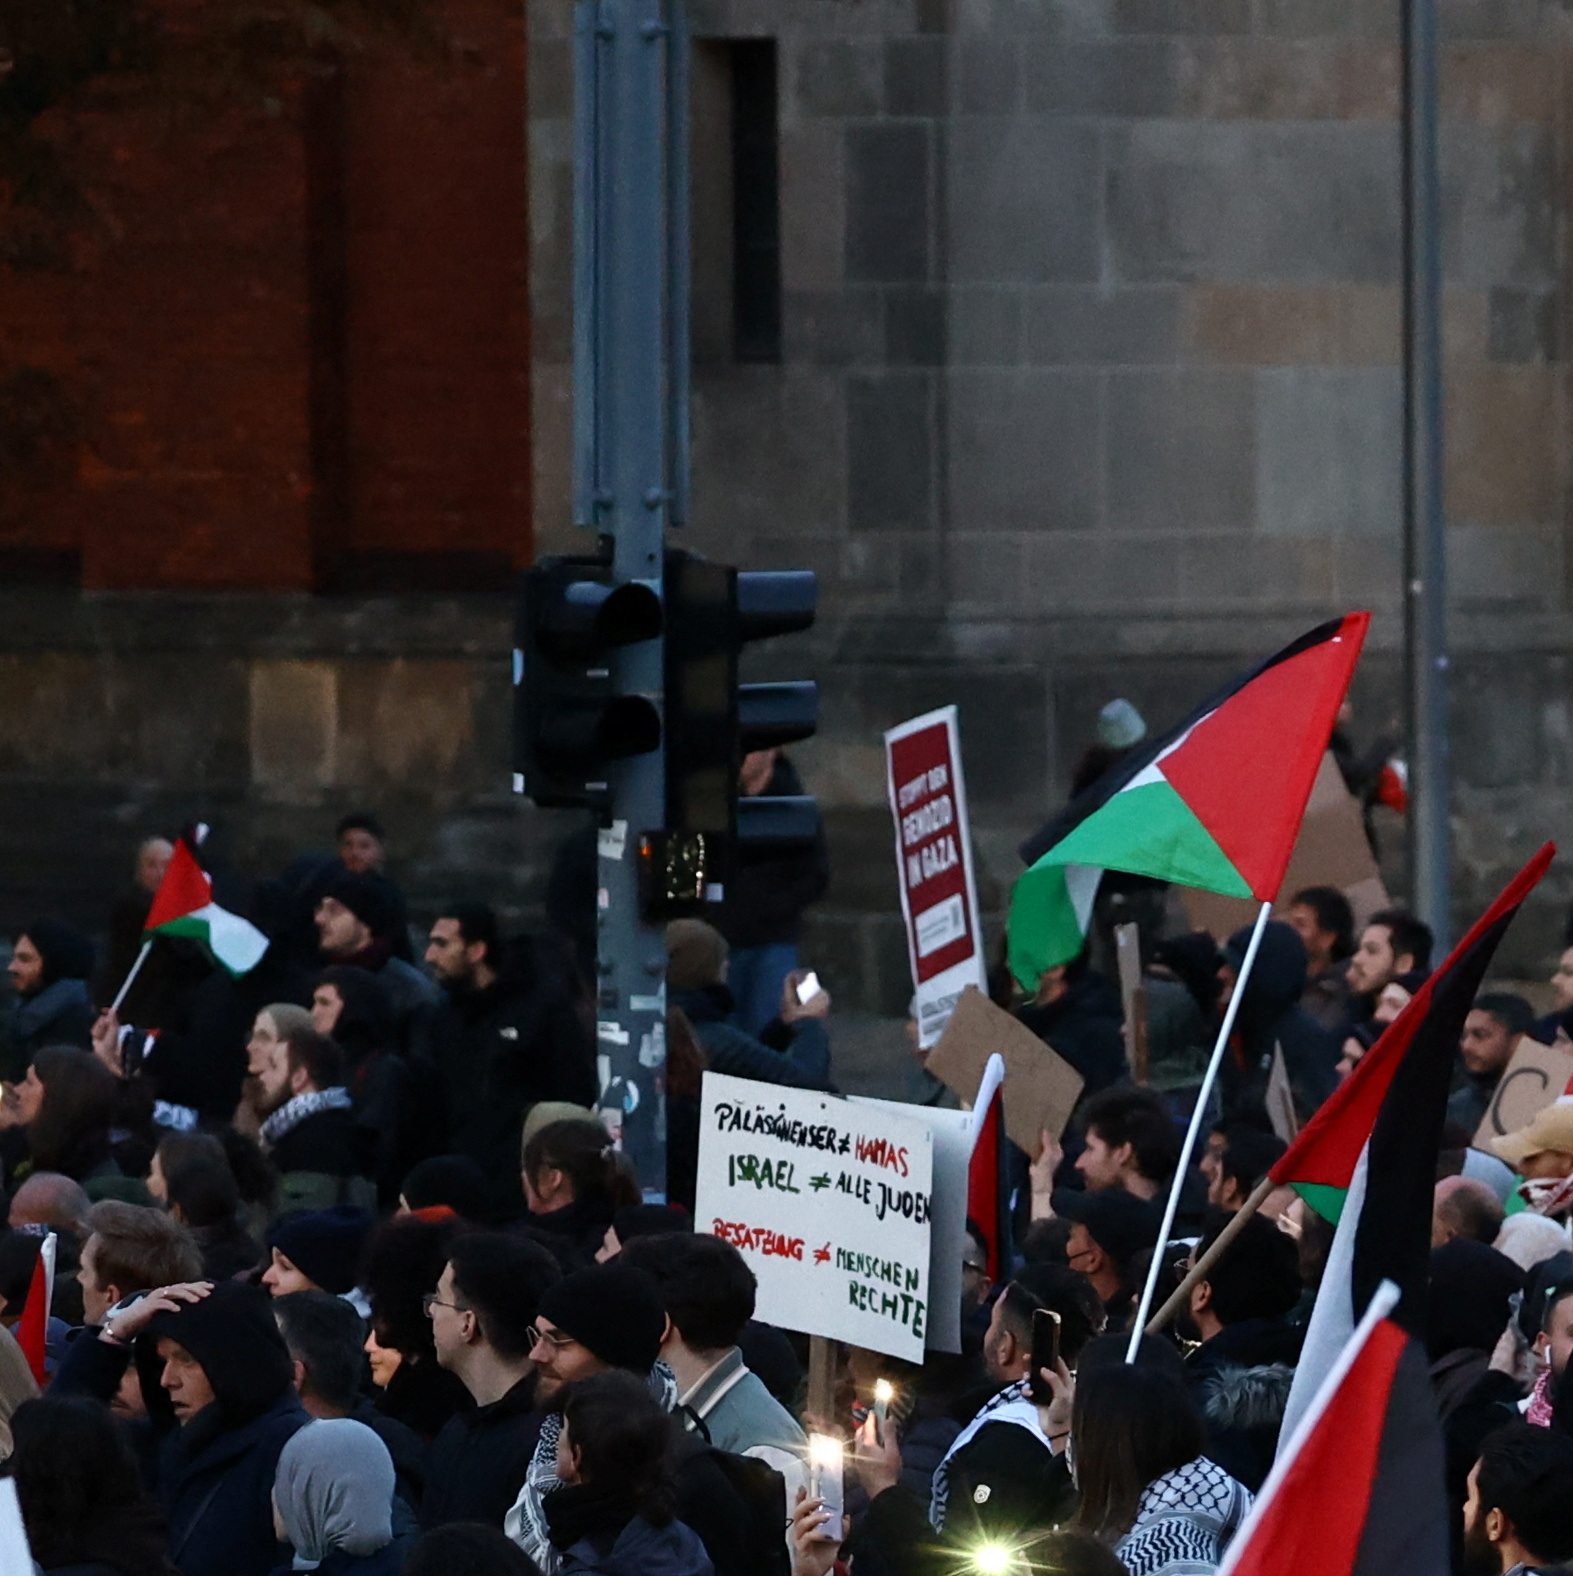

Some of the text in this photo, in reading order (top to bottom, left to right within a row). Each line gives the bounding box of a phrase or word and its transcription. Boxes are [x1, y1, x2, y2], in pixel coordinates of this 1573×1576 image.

[728, 1153, 800, 1193] ISRAEL
[834, 1170, 871, 1205] ALLE
[854, 1133, 909, 1177] HAMAS
[712, 1217, 805, 1261] BESATZUNG
[836, 1247, 919, 1292] MENSCHEN
[849, 1279, 926, 1339] RECHTE
